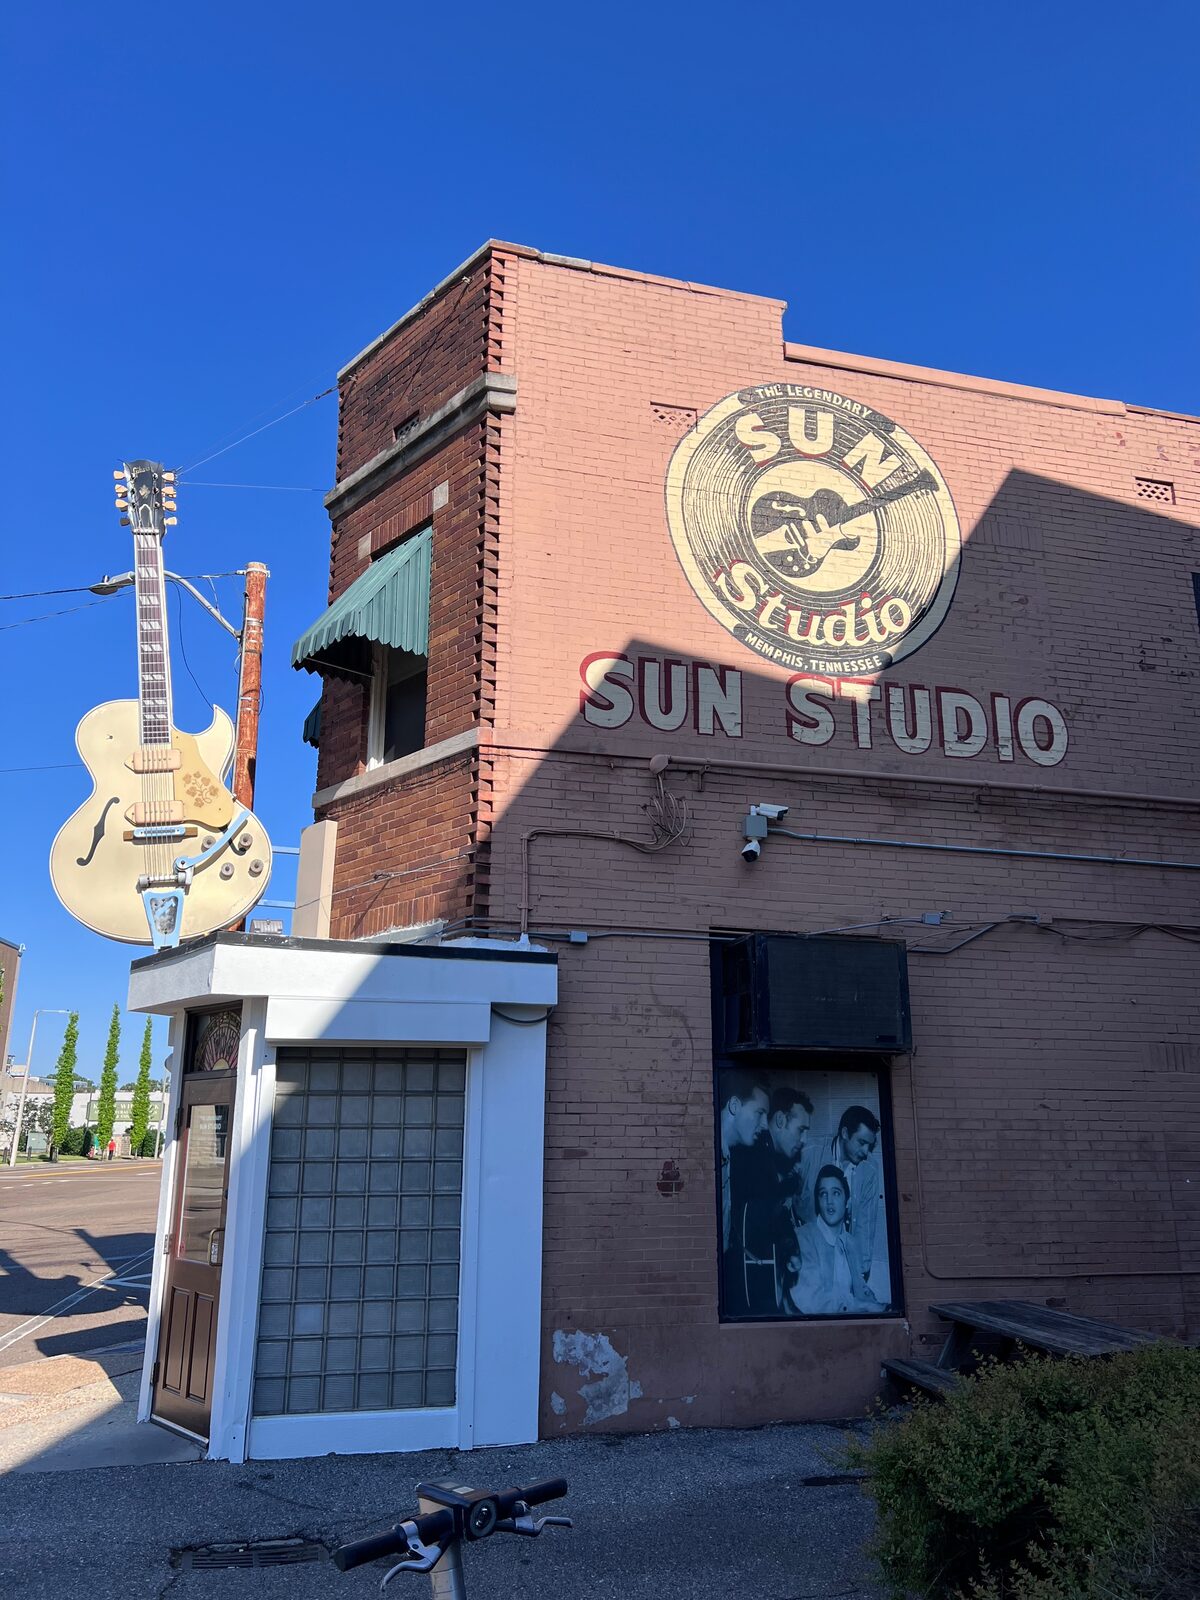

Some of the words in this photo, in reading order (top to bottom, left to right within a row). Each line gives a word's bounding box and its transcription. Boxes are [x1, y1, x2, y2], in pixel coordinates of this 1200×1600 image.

[755, 384, 783, 399] THE
[786, 384, 873, 419] LEGENDARY
[735, 406, 905, 491] SUN
[713, 559, 912, 647] Studio
[744, 632, 808, 670] MEMPHIS,
[809, 655, 882, 673] TENNESSEE
[580, 651, 743, 738] SUN
[786, 672, 1070, 767] STUDIO
